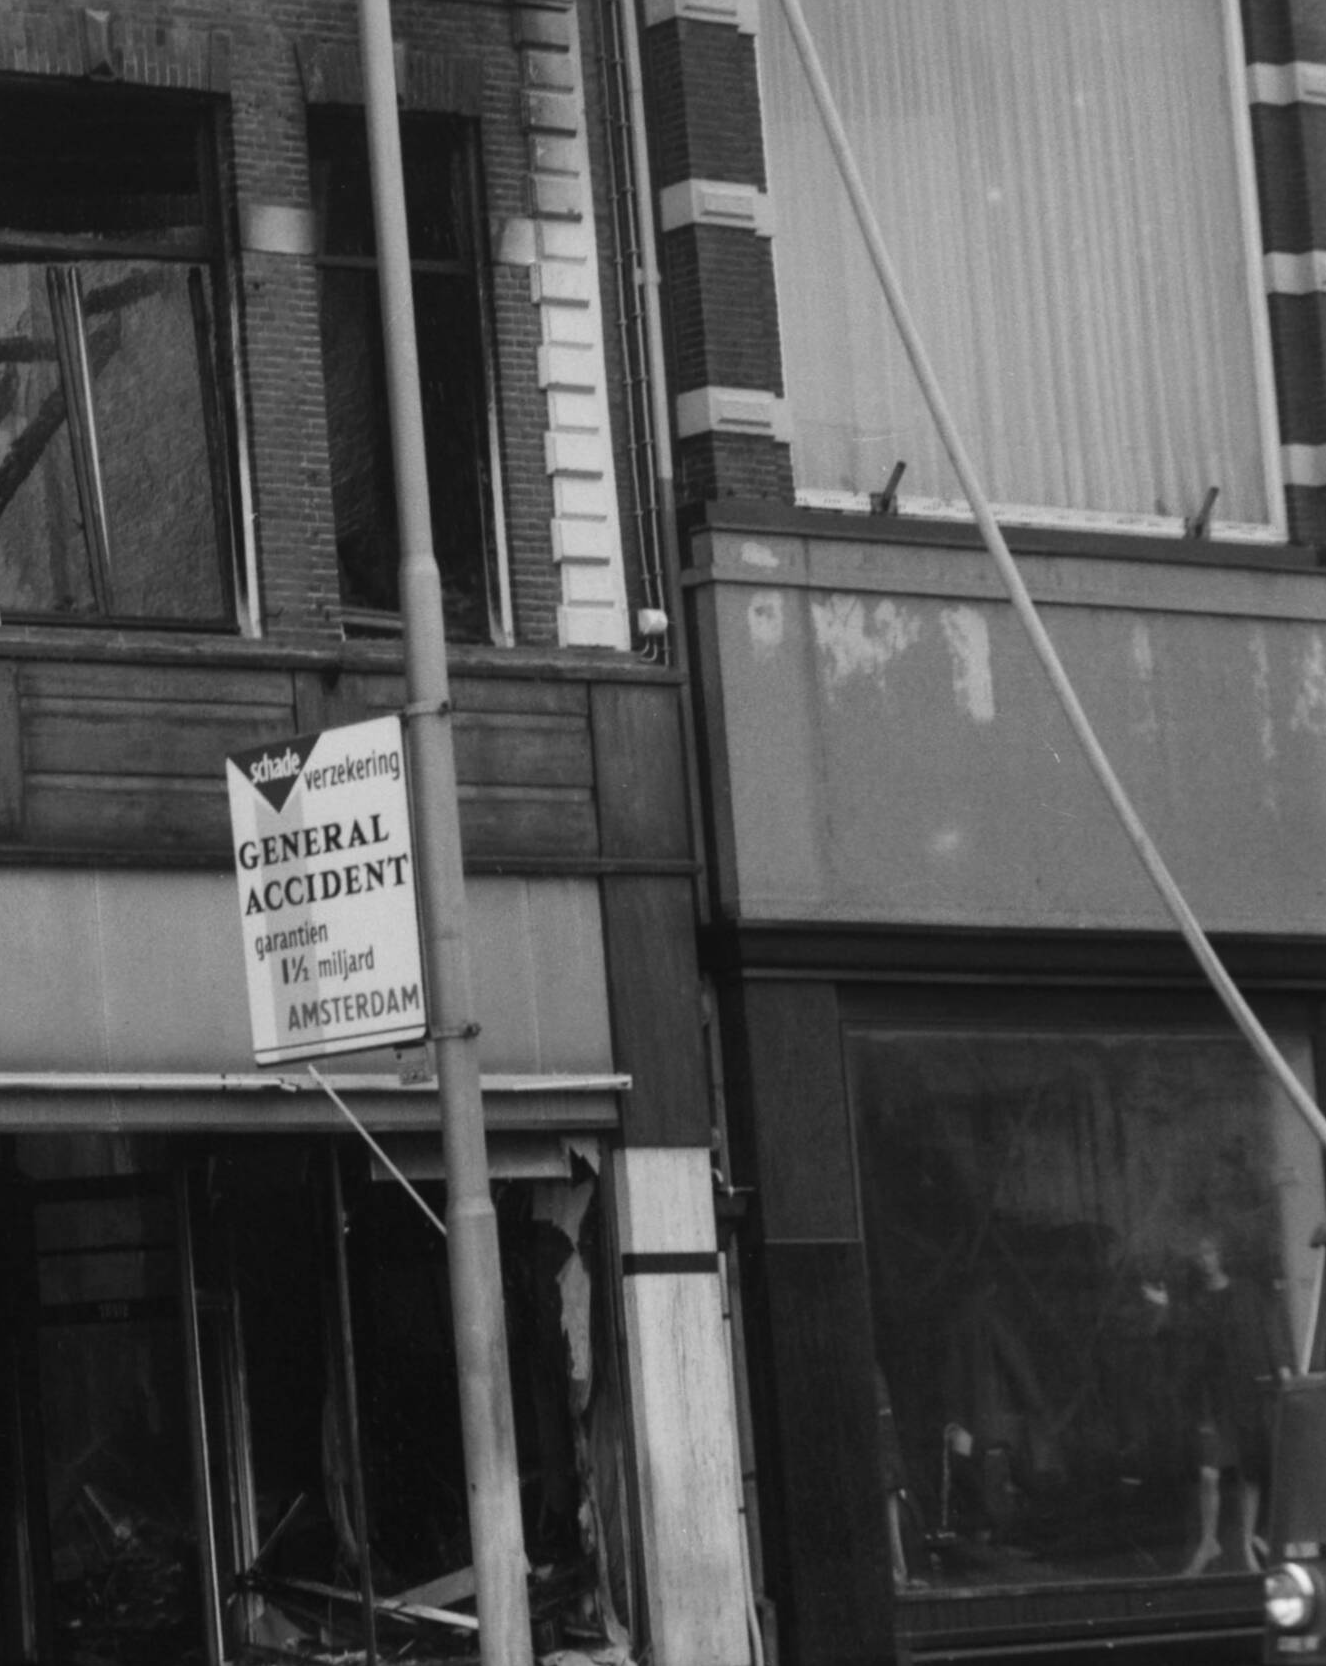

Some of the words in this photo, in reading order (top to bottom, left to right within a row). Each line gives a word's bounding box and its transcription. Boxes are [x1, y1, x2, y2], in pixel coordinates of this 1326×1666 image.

[249, 747, 301, 784] schade
[304, 750, 401, 792] verzekering
[238, 813, 390, 871] GENERAL
[244, 853, 410, 917] ACCIDENT
[254, 923, 329, 962] garantien
[318, 946, 375, 981] miljard
[287, 984, 422, 1032] AMSTERDAM
